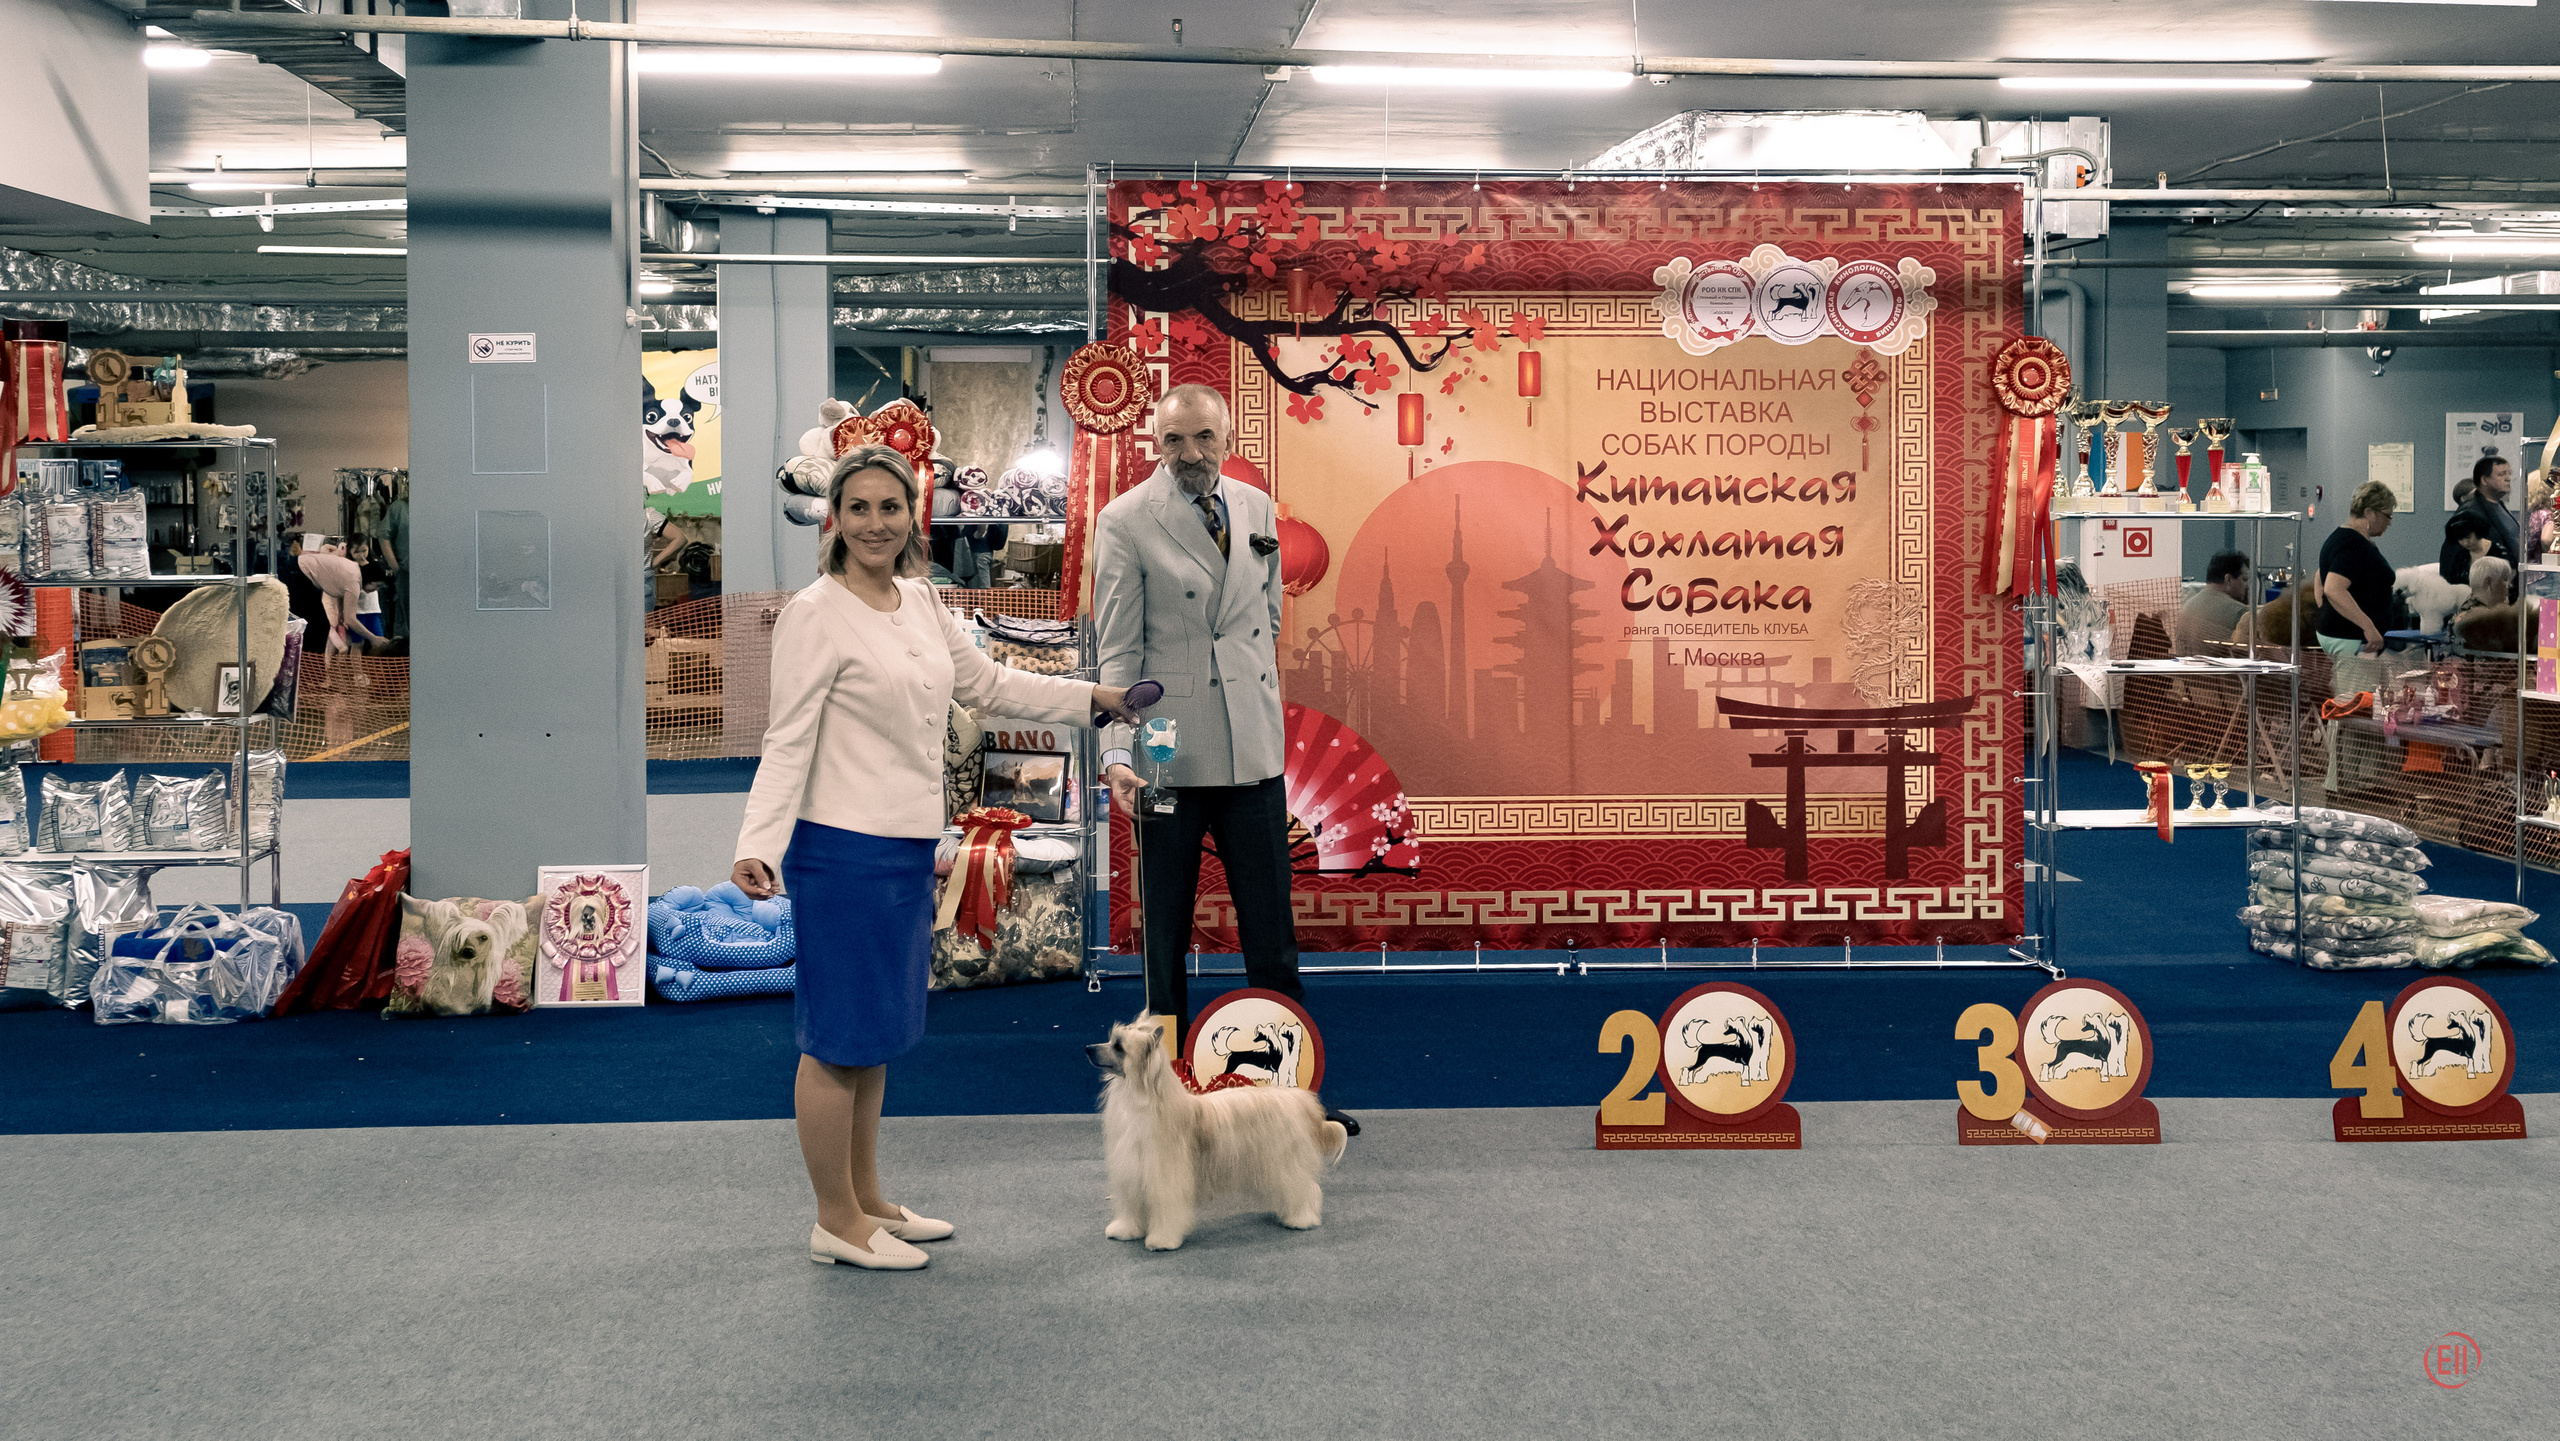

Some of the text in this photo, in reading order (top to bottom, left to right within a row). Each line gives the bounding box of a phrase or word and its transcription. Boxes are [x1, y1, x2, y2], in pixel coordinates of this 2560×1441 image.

[1834, 264, 1899, 290] КИНОЛОГИЧЕСКАЯ
[1828, 291, 1903, 338] РОССИЙСКАЯ ФЕДЕРАЦИЯ
[1596, 368, 1836, 396] НАЦИОНАЛЬНАЯ
[1640, 401, 1794, 423] ВЫСТАВКА
[1601, 433, 1831, 460] СОБАК ПОРОДЫ
[1576, 460, 1857, 506] Китайская
[1588, 513, 1844, 560] Хохлатая
[1623, 623, 1809, 638] ранга ПОБЕДИТЕЛЬ КЛУБА
[1667, 647, 1766, 667] г. Москва
[984, 729, 1056, 751] BRAVO
[1597, 1008, 1667, 1126] 2
[1954, 1002, 2026, 1121] 3
[2329, 999, 2404, 1119] 4
